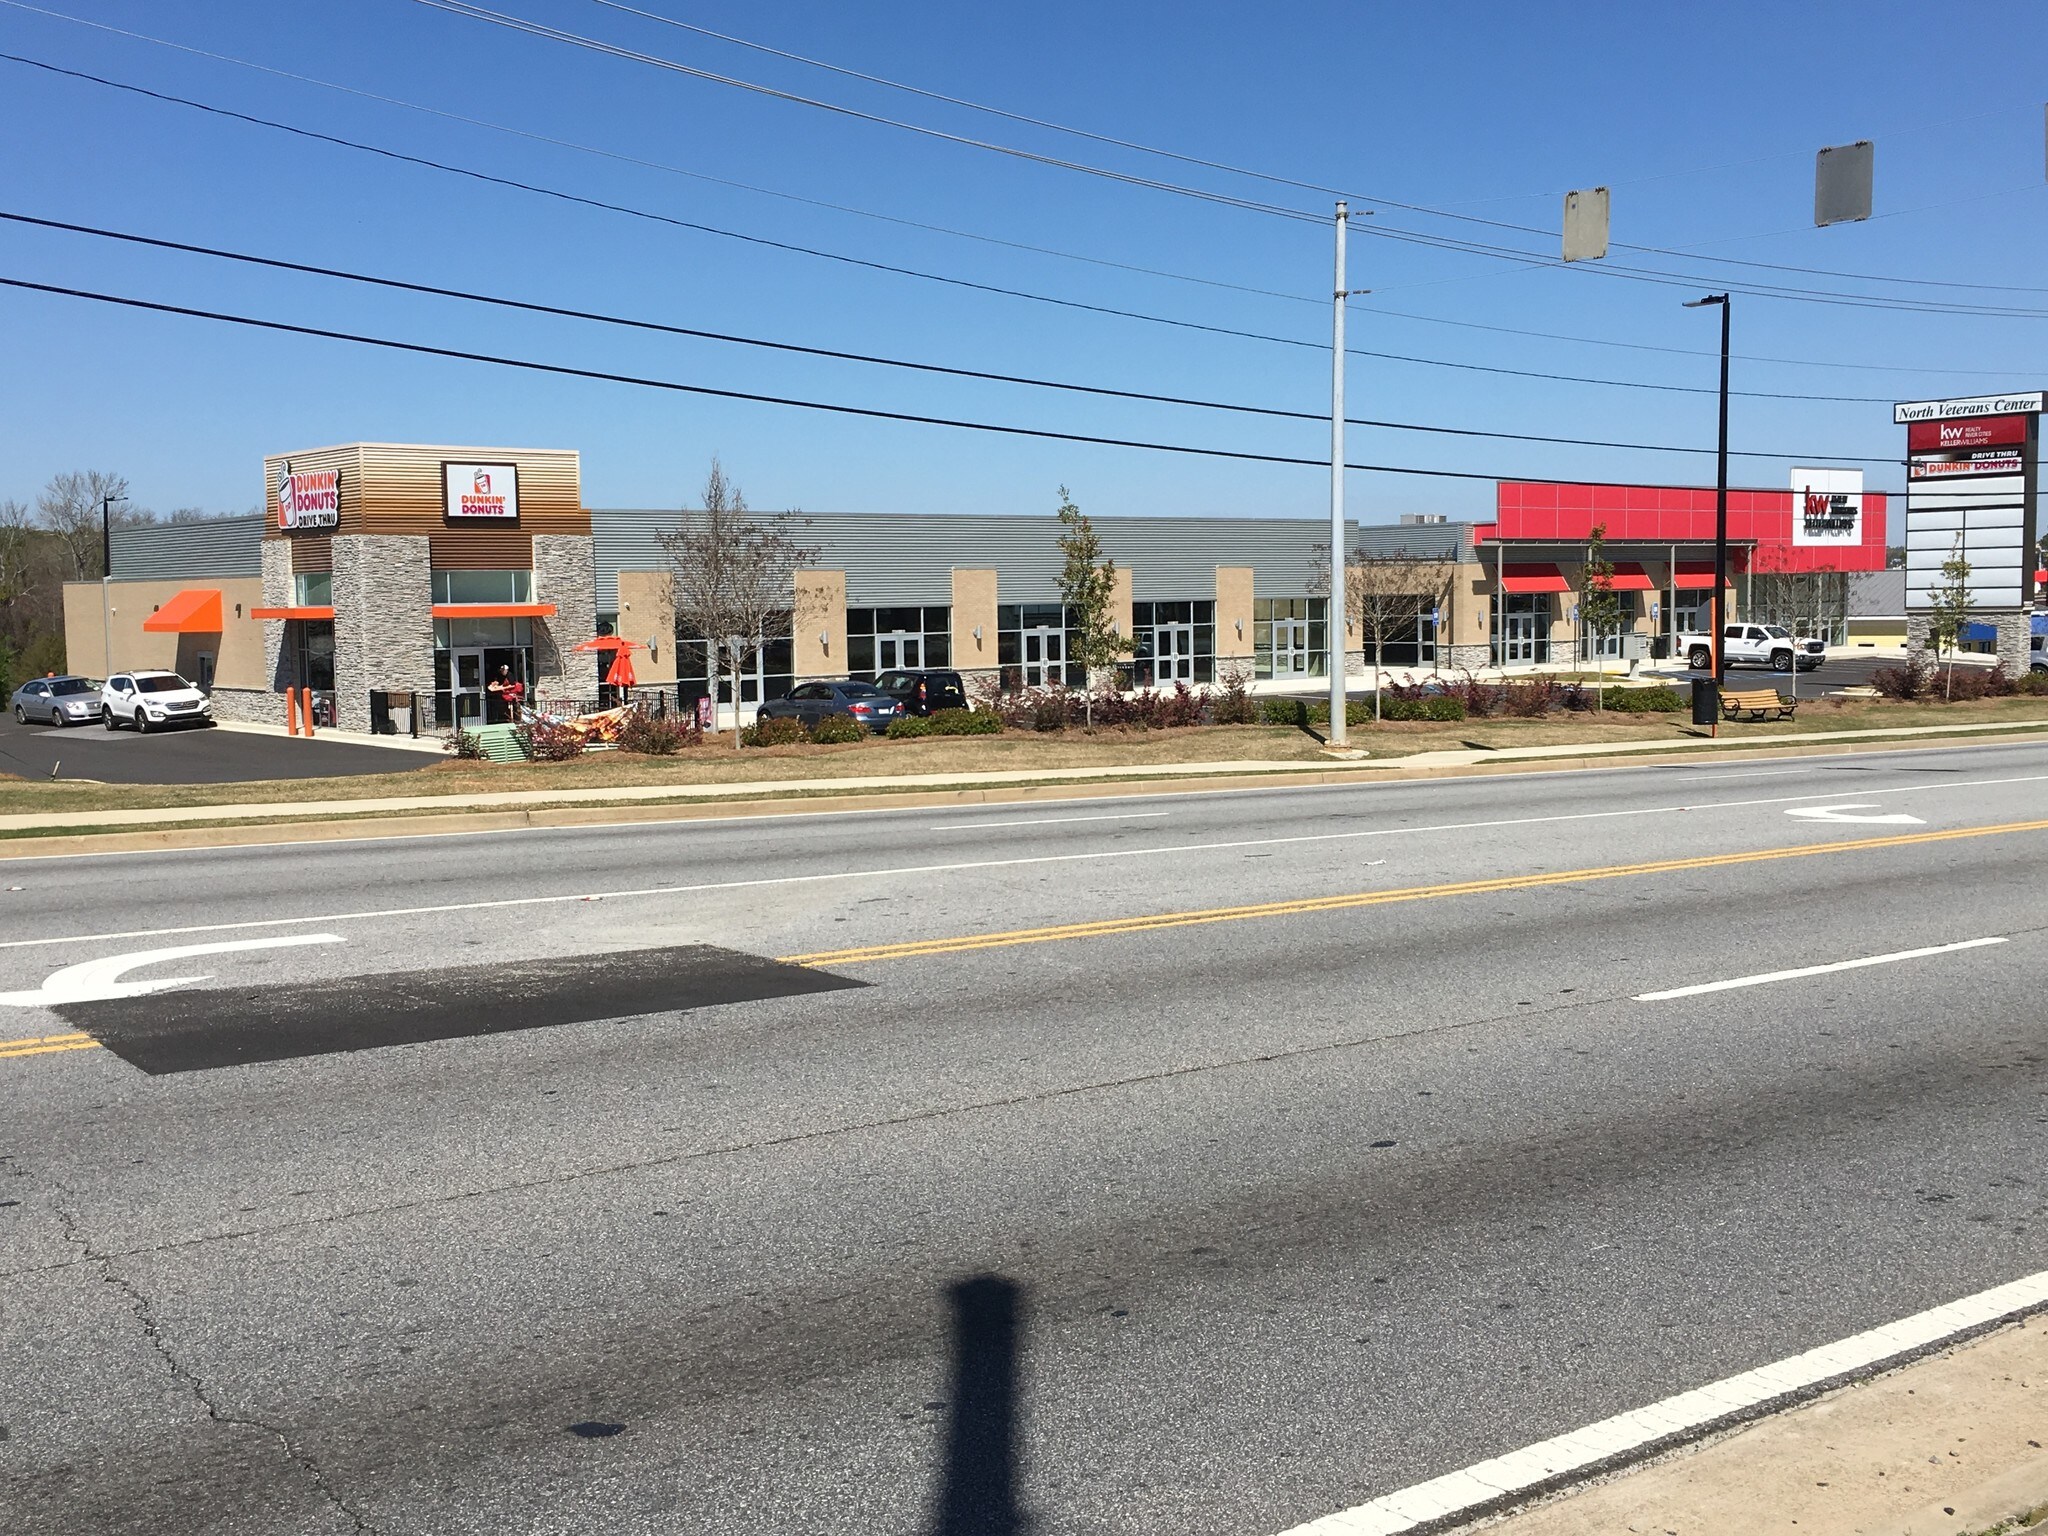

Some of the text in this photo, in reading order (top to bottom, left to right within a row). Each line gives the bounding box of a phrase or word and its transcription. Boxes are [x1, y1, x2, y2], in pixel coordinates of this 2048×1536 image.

[1898, 399, 2037, 420] North Veterans Center
[1940, 423, 1963, 440] kw
[1971, 451, 1995, 459] DRIVE
[1974, 459, 2018, 472] DONUTS
[296, 470, 337, 493] DUNKIN'
[297, 491, 336, 512] DONUTS
[461, 495, 506, 504] DUNKIN'
[462, 504, 504, 515] DONUTS
[299, 513, 336, 527] DRIVE THRU
